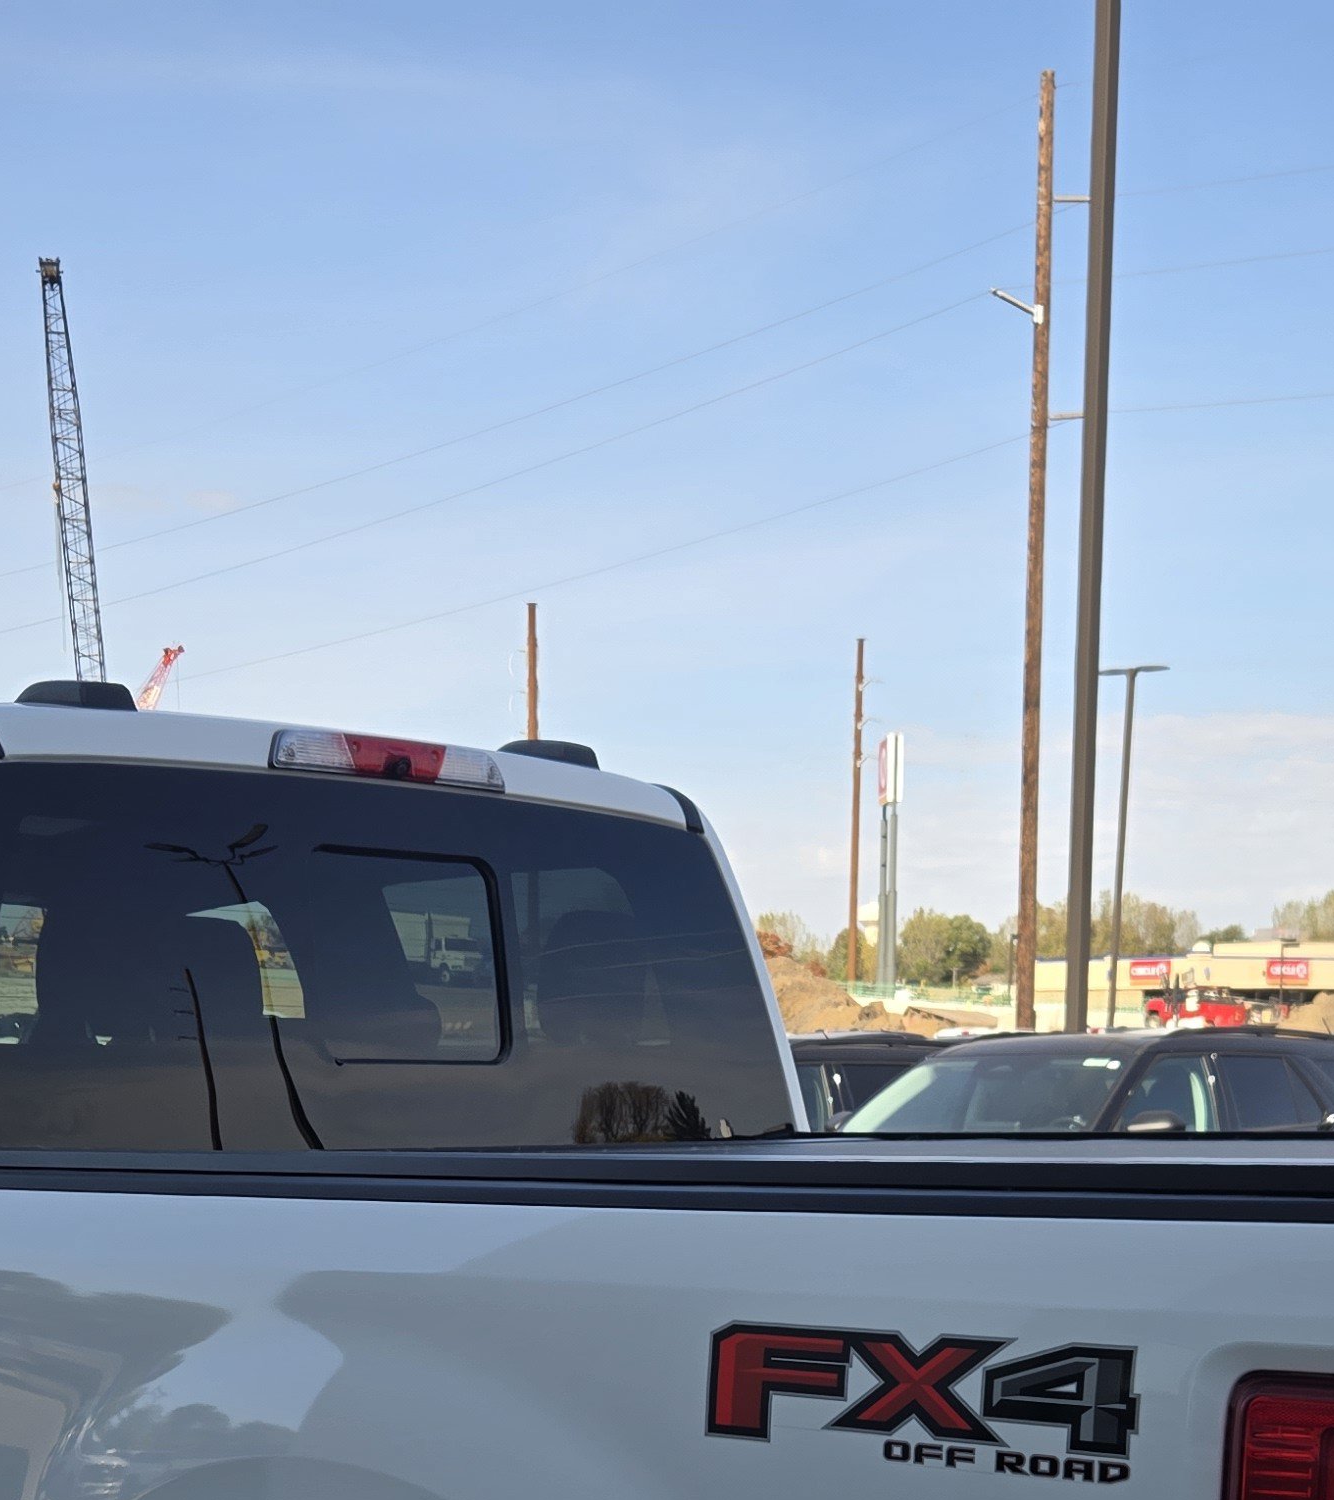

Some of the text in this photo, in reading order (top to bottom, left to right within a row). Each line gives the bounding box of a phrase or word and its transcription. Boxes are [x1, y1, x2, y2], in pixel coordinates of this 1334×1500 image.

[705, 1320, 1141, 1459] FX4
[883, 1438, 1131, 1484] OFF ROAD
